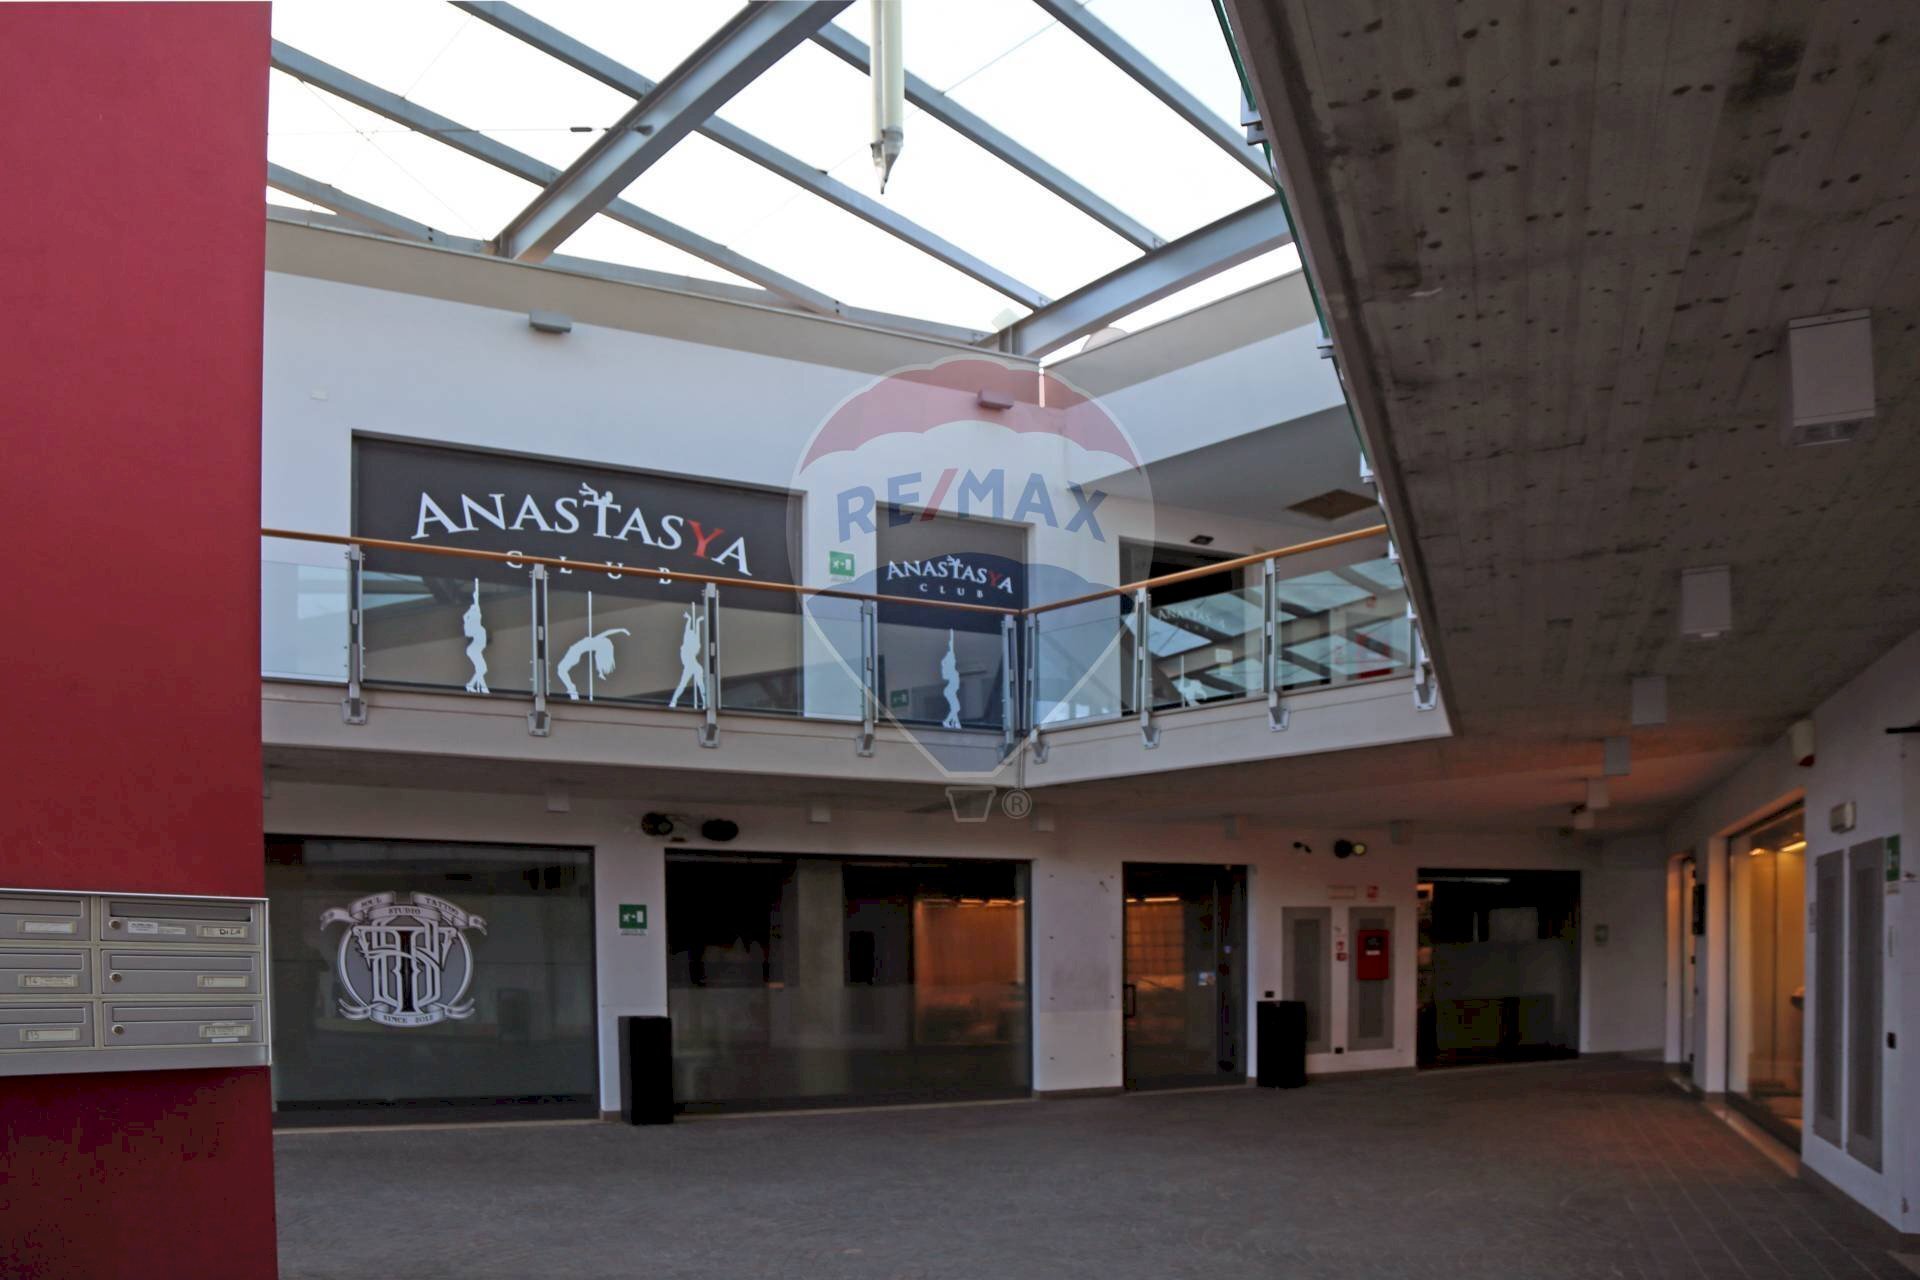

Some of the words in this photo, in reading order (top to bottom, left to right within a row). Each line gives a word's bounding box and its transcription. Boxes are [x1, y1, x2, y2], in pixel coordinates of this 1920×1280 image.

[411, 488, 752, 577] ANASTASYA
[505, 550, 673, 585] CLUB
[886, 556, 1014, 596] ANASTASYA
[919, 583, 984, 600] CLUB
[388, 907, 421, 915] STUDIO
